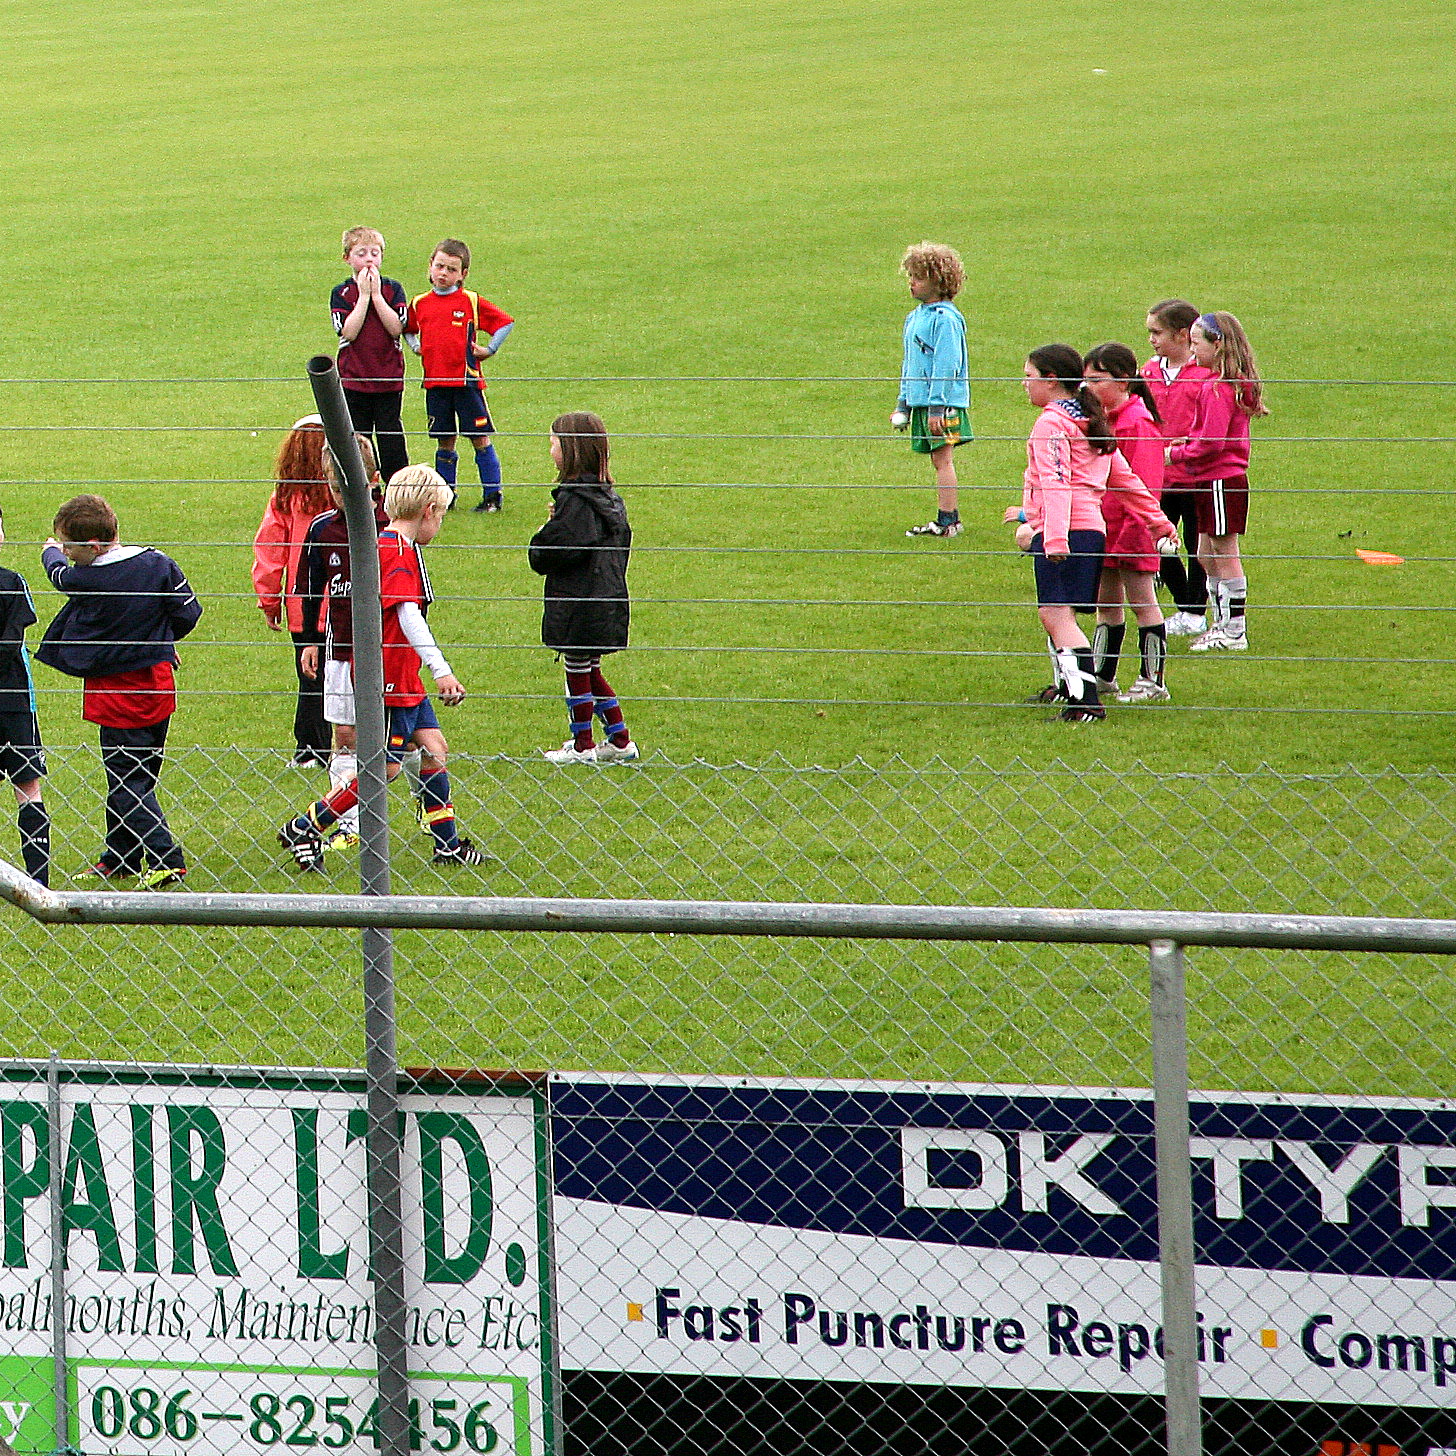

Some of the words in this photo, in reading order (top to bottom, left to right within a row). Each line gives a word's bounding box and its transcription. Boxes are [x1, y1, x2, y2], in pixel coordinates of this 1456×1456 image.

[900, 1126, 1126, 1216] DK
[205, 1285, 468, 1351] Maintennce
[477, 1295, 541, 1351] Etc.
[654, 1286, 764, 1345] Fast
[784, 1292, 1027, 1357] Puncture
